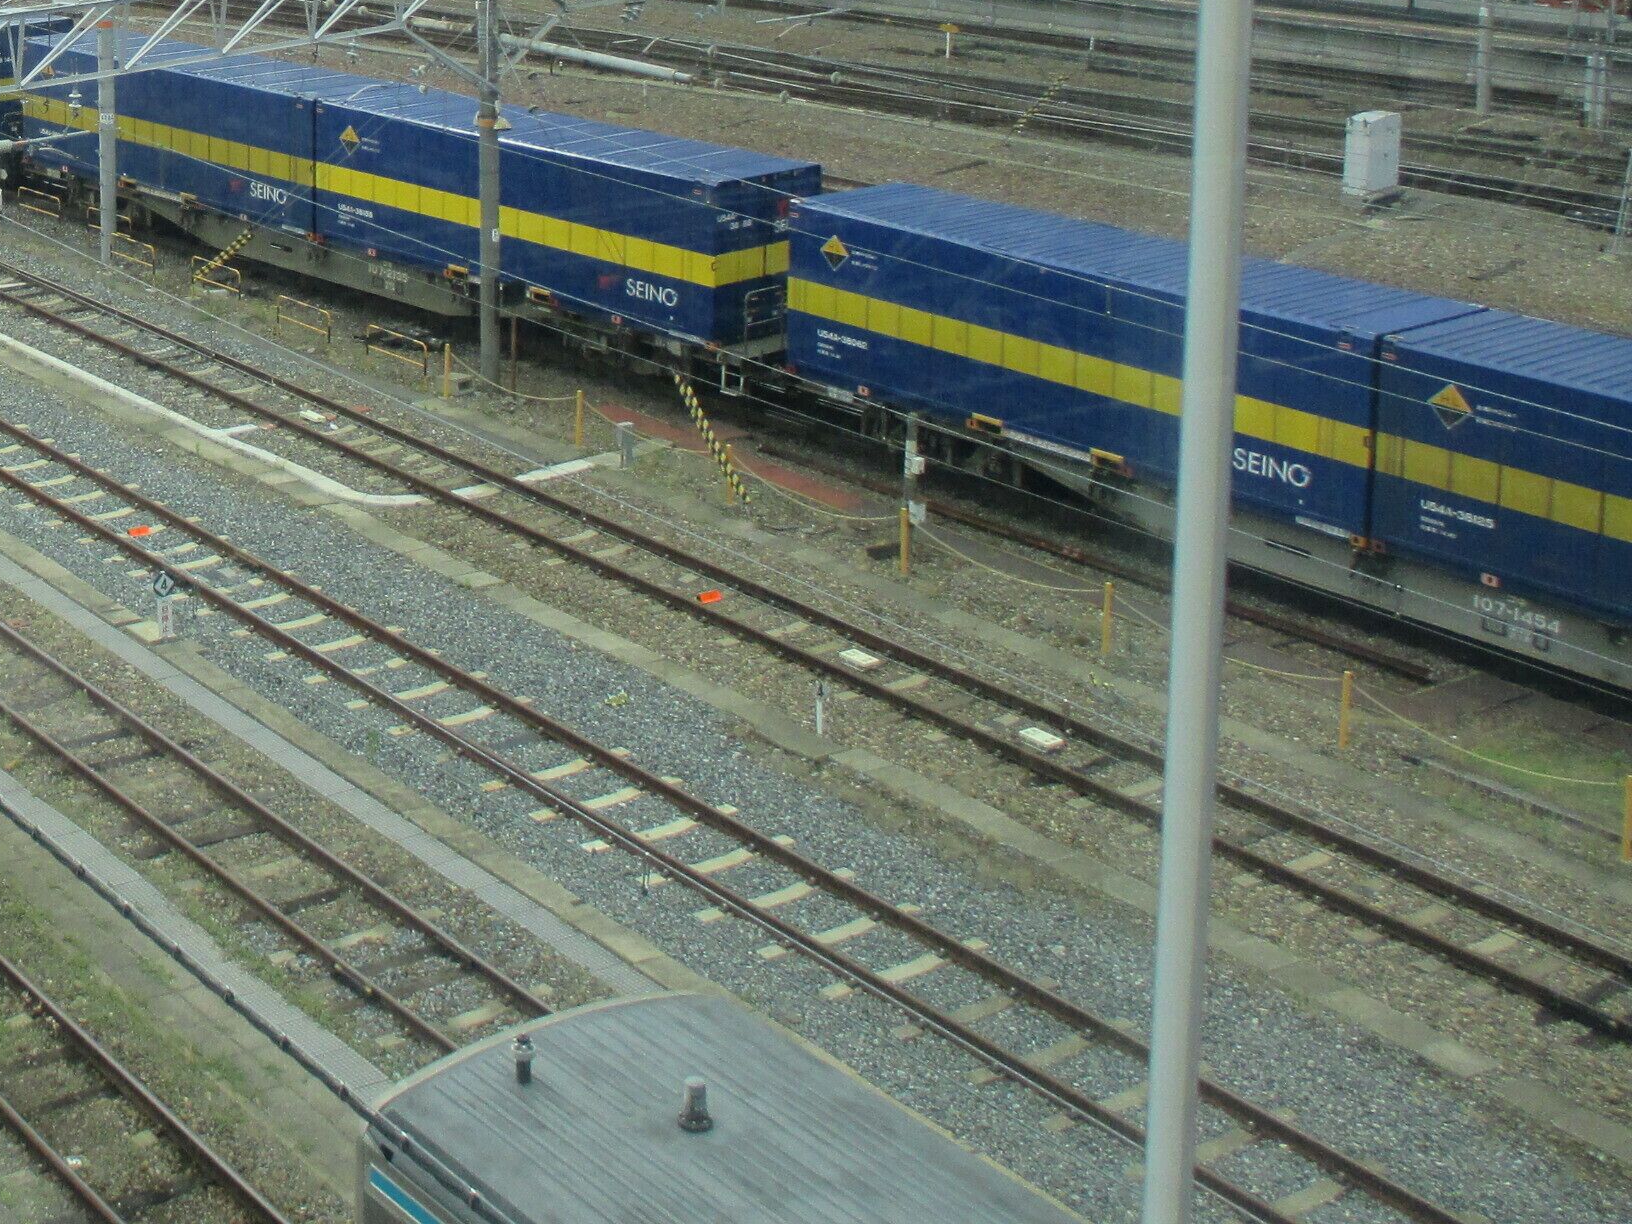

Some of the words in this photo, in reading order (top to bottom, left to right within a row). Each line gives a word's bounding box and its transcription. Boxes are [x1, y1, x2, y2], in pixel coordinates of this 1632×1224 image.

[249, 181, 287, 204] SEINO
[626, 278, 678, 307] SEINO
[1232, 447, 1312, 487] SEINO
